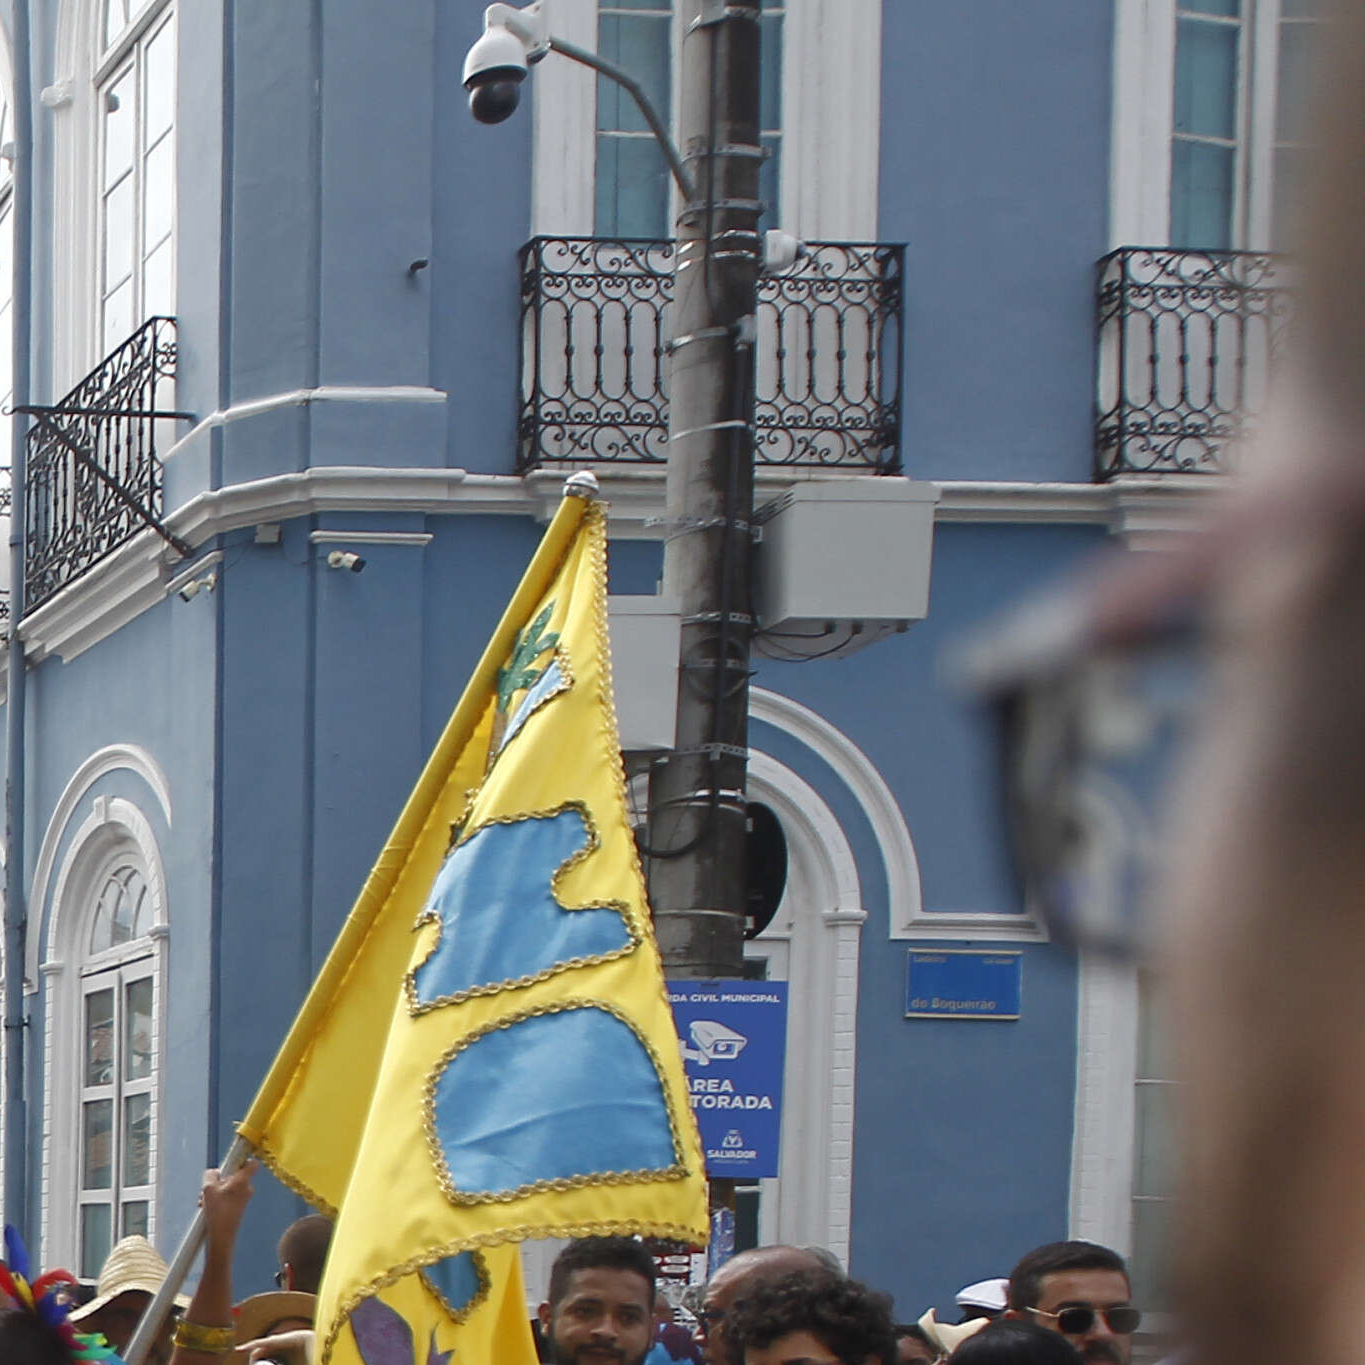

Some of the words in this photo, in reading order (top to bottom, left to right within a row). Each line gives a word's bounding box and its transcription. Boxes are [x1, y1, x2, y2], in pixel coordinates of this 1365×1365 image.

[690, 994, 719, 1002] CIVIL
[721, 994, 781, 1003] MUNICIPAL
[690, 1094, 772, 1110] TORADA
